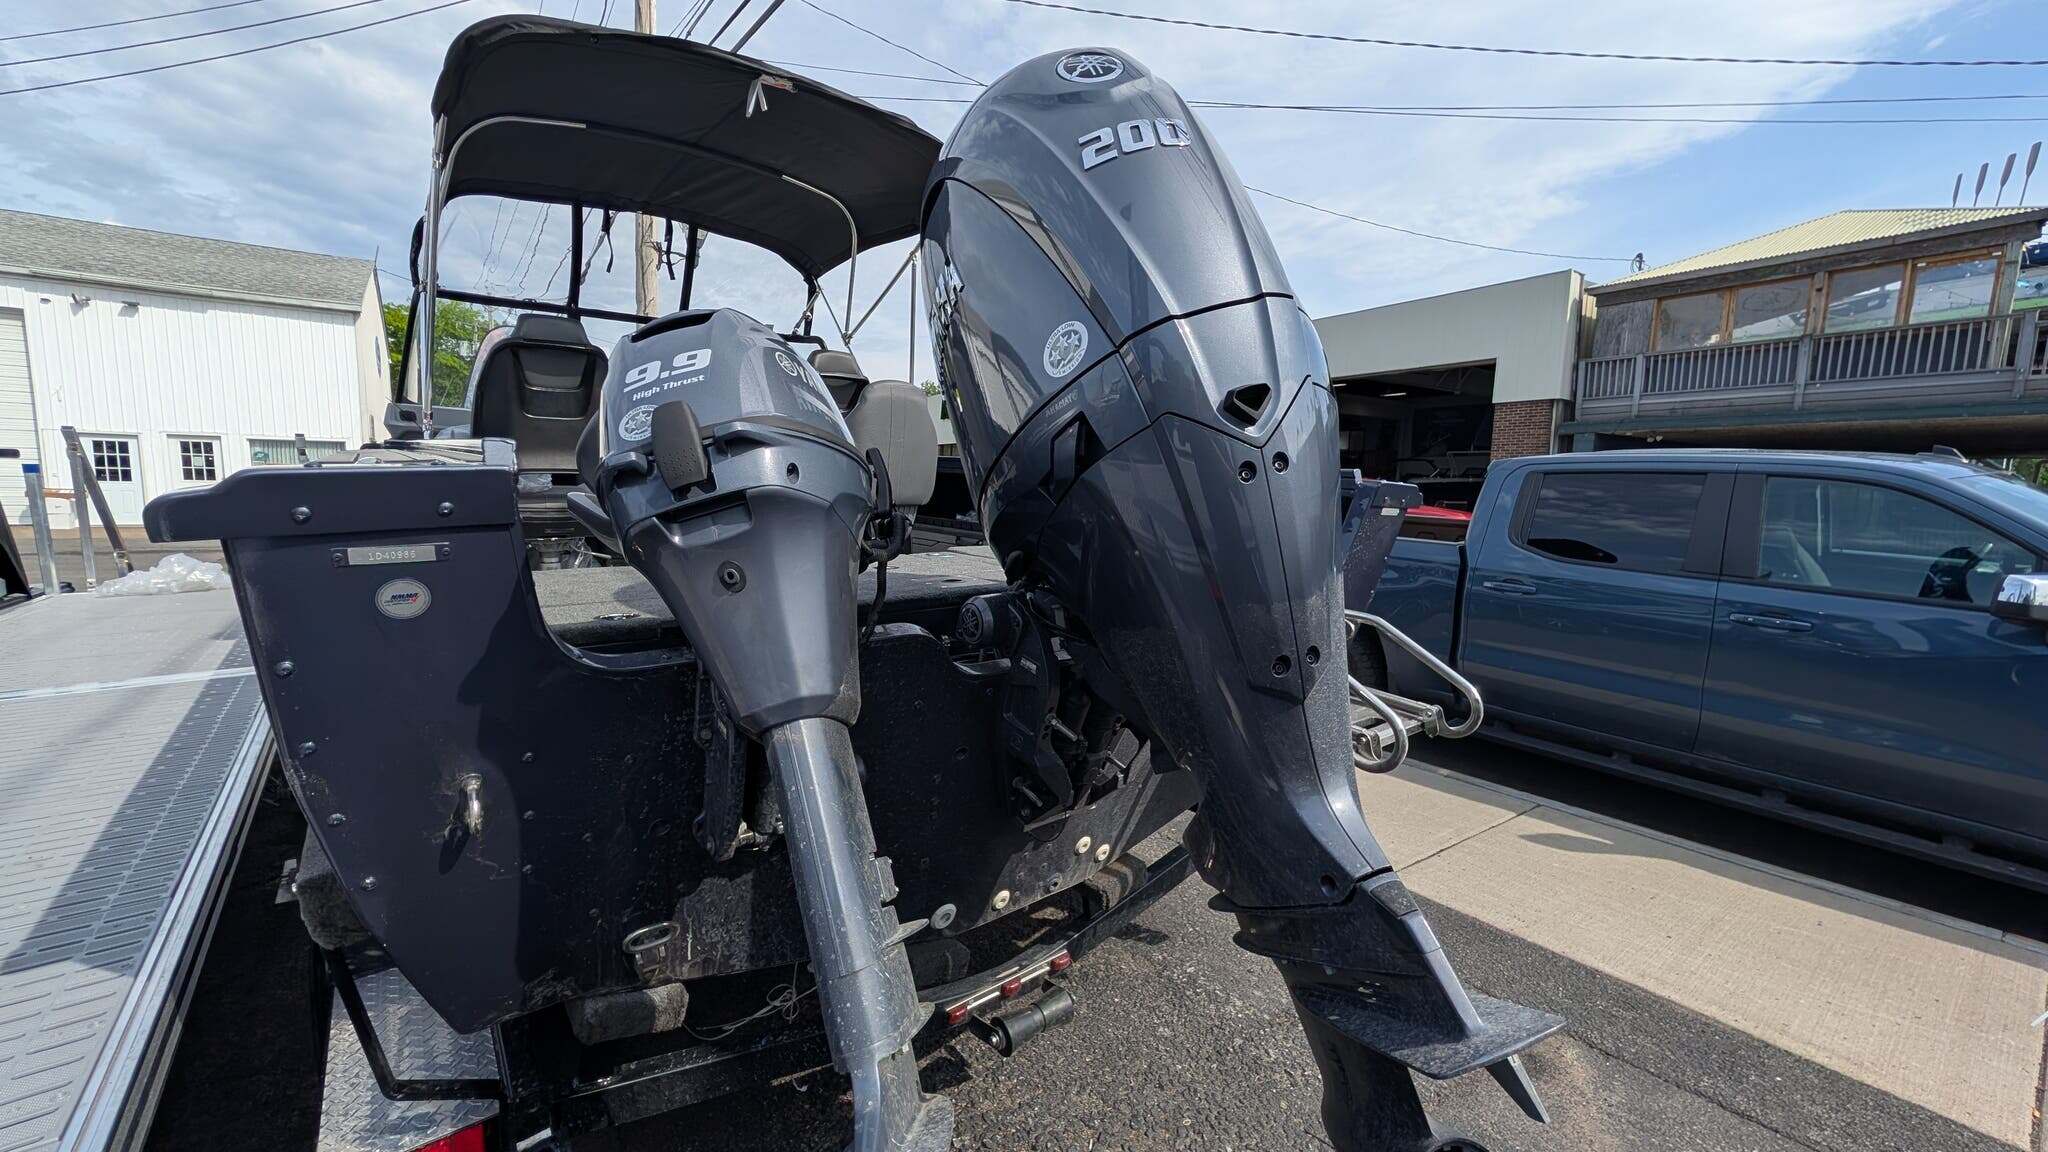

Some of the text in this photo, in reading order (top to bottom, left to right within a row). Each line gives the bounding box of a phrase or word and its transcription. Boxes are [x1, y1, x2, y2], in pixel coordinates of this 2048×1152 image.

[1078, 117, 1191, 170] 200
[623, 348, 712, 393] 9.9
[633, 374, 705, 401] High Thrust
